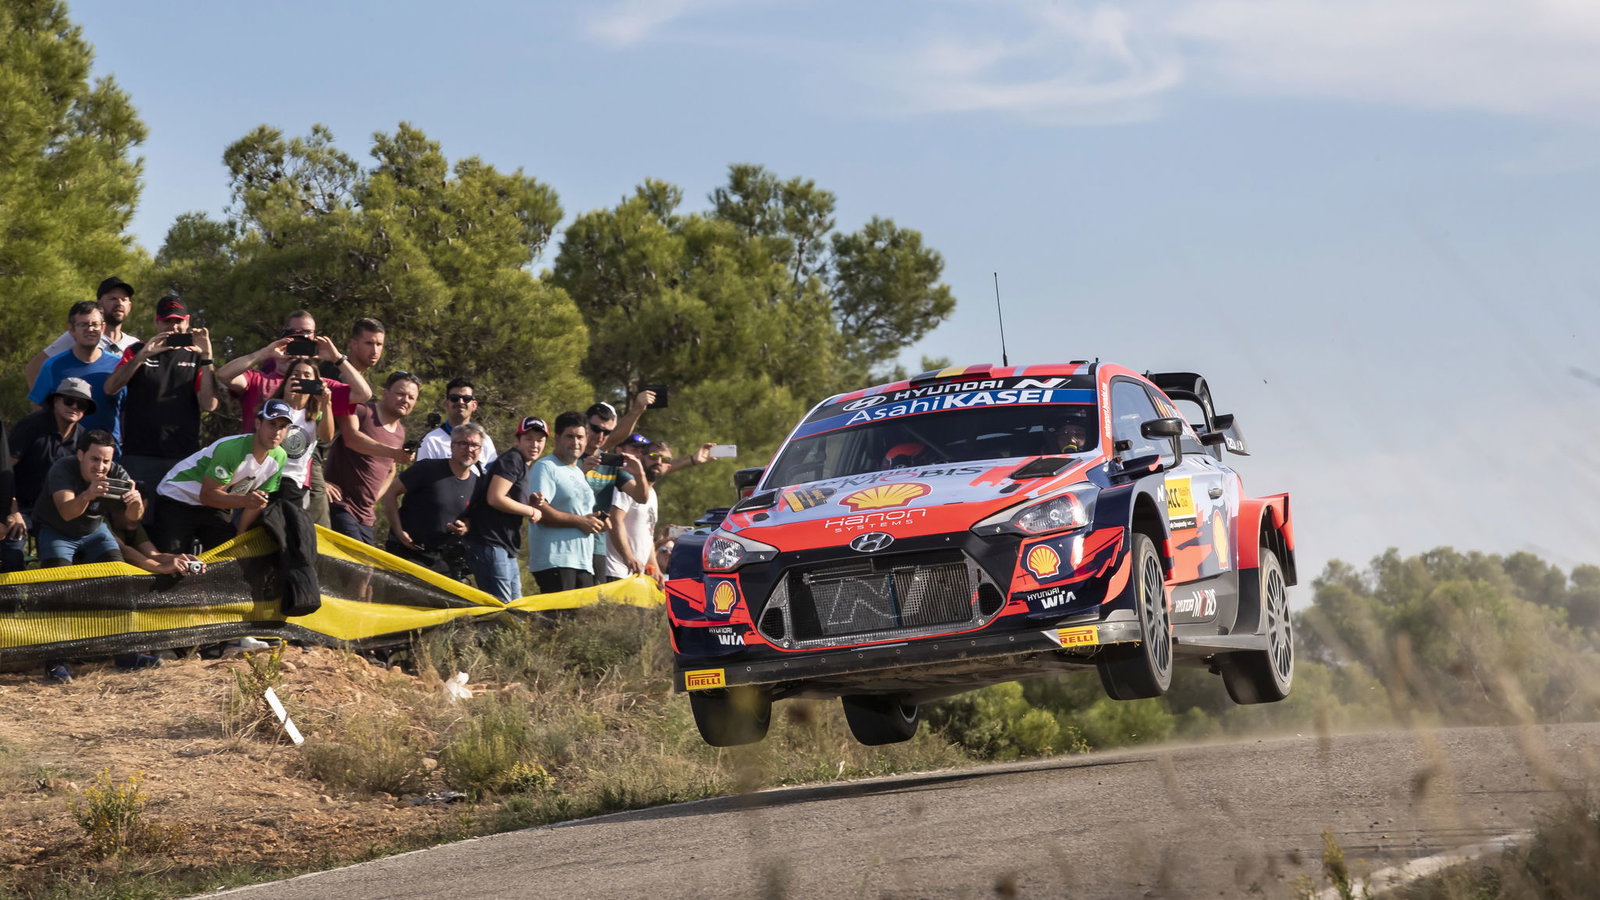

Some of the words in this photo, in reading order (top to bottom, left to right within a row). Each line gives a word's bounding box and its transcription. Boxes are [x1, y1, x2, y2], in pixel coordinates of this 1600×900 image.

[894, 380, 1004, 401] HYUNDAI
[845, 390, 1053, 426] AsahiKASEI
[1165, 488, 1181, 509] ACC
[834, 519, 913, 533] SYSTEMS
[1027, 587, 1060, 601] HYUNDAI
[1058, 629, 1094, 645] RELLI
[687, 672, 721, 687] PIRELLI
